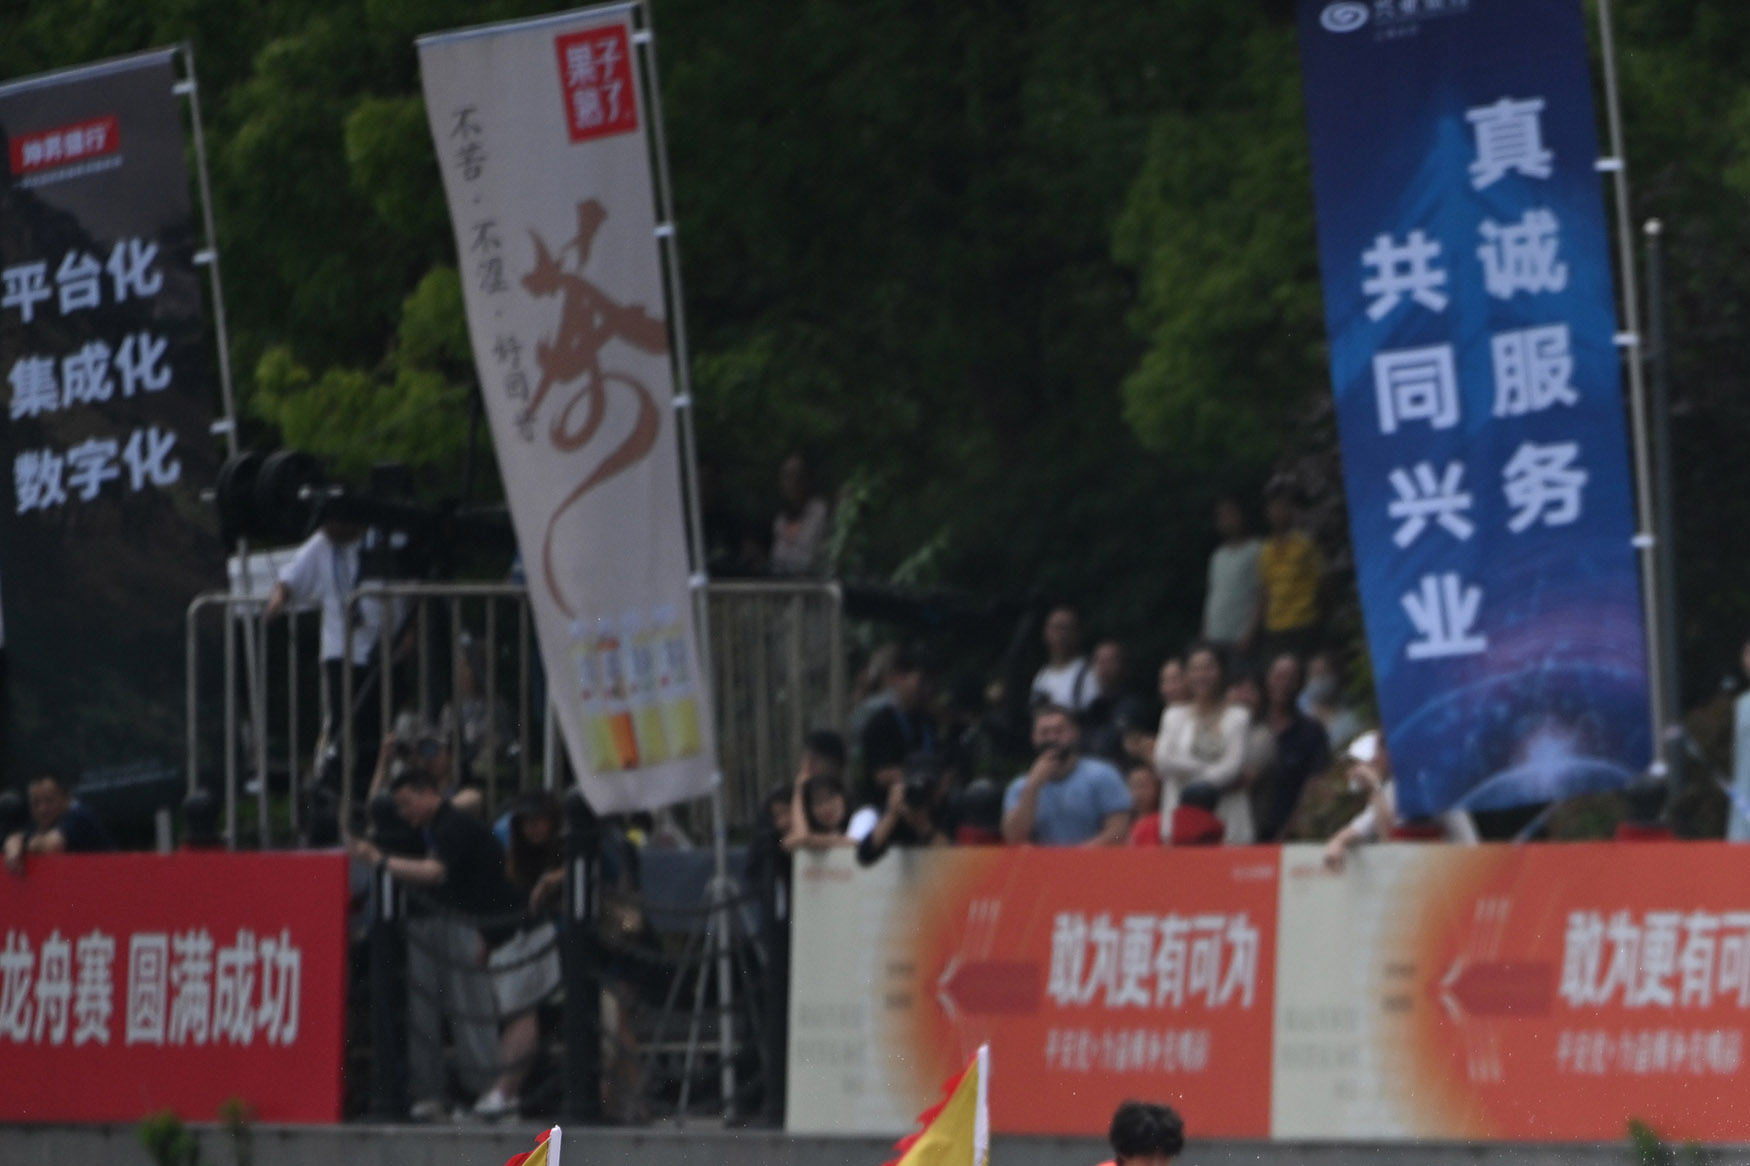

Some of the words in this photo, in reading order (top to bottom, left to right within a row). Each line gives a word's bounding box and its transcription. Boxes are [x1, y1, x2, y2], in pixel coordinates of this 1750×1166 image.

[1, 237, 165, 323] 平台化
[1464, 97, 1590, 535] 真诚服务
[7, 331, 172, 421] 集成化
[13, 427, 182, 515] 数字化
[1360, 229, 1489, 661] 共同兴业
[0, 927, 116, 1047] 龙舟赛
[126, 927, 301, 1048] 圆满成功
[1046, 910, 1262, 1009] 敢为更有可为
